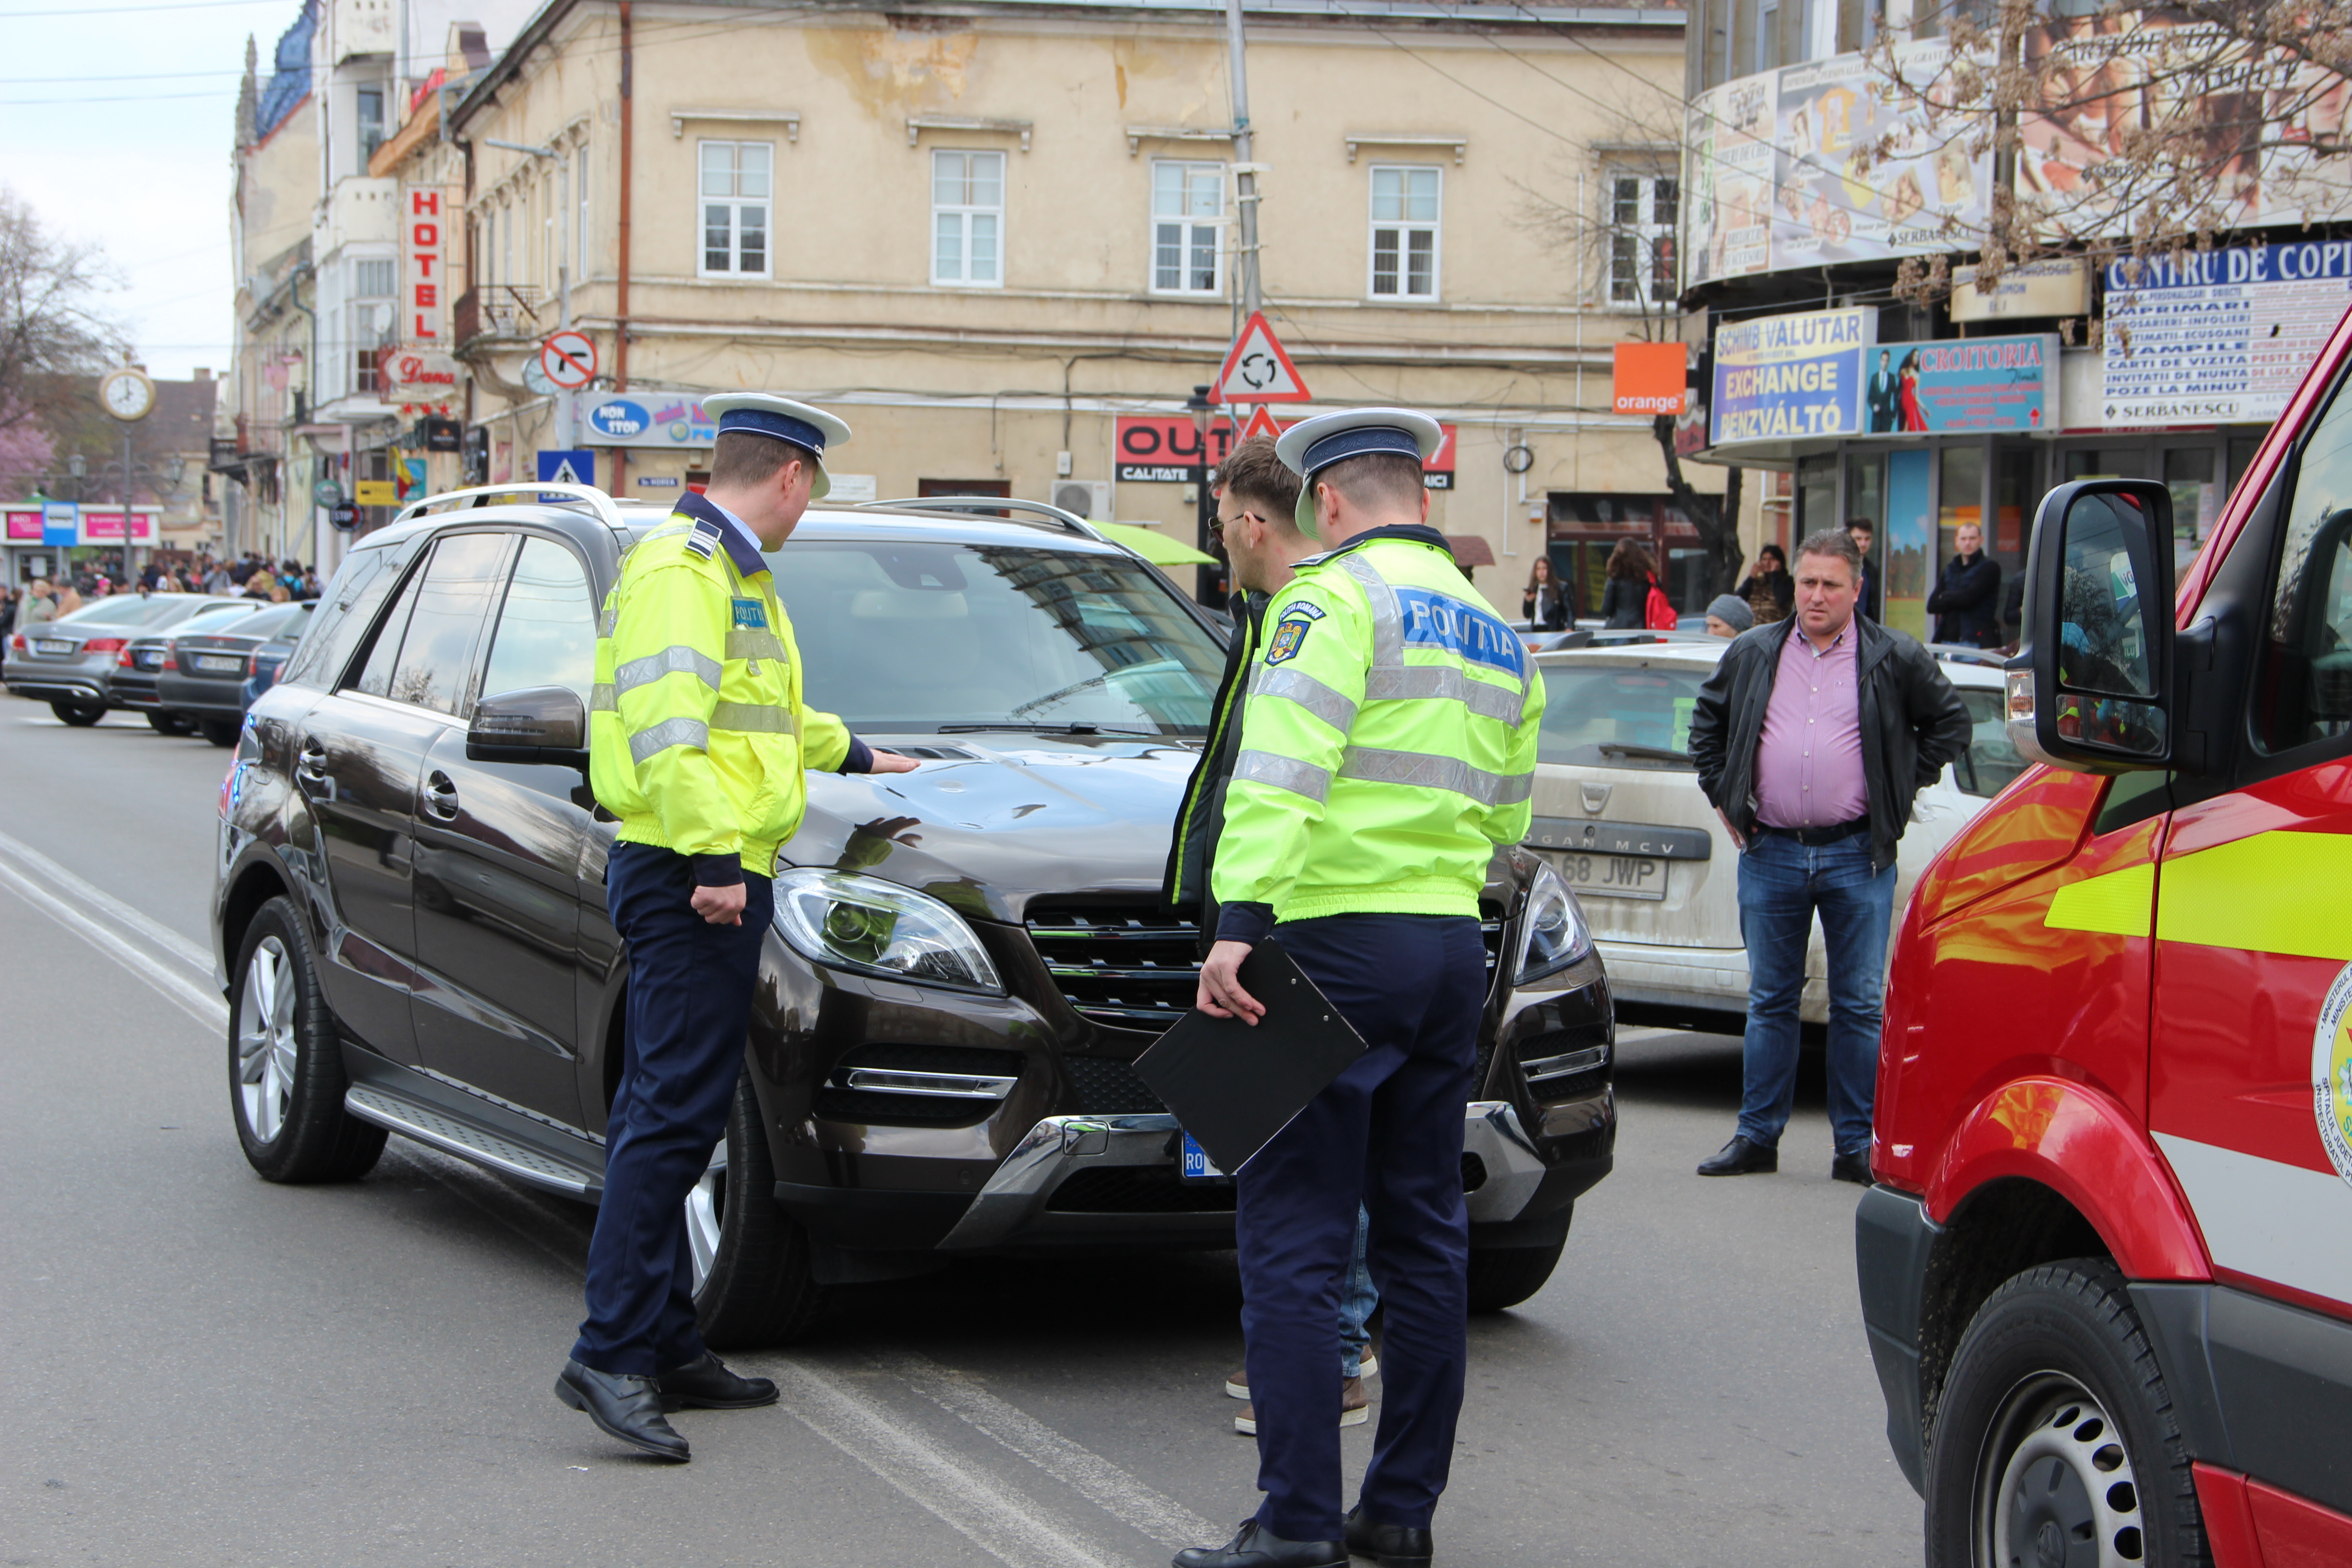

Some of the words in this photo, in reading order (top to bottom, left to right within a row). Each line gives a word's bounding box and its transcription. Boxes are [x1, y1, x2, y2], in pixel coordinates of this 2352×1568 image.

[413, 191, 438, 338] HOTEL
[2109, 250, 2219, 290] CNTRU
[2228, 246, 2268, 283] DE
[1718, 324, 1759, 358] SCHIMB
[1765, 315, 1860, 348] VALUTAR
[400, 356, 454, 385] Dana
[1921, 342, 2042, 372] CROITORIA
[2107, 359, 2154, 369] CARTI
[2161, 358, 2181, 367] DE
[2190, 355, 2248, 365] VIZITA
[2252, 353, 2291, 363] PESTE
[1725, 362, 1838, 400] EXCHANGE
[2106, 386, 2151, 396] POZE
[2159, 384, 2178, 393] LA
[2186, 382, 2248, 392] MINUT
[2107, 372, 2169, 383] INVITATII
[2175, 371, 2191, 380] DE
[2198, 368, 2248, 378] NUNTA
[599, 406, 626, 420] NON
[654, 399, 686, 425] mini
[1617, 396, 1678, 412] orange
[1720, 397, 1842, 440] PÉNZVÁLTÓ
[2123, 402, 2239, 417] SERBANESCU
[608, 421, 641, 434] STOP
[1122, 467, 1188, 480] CALITATE
[335, 510, 354, 521] STOP
[1410, 600, 1516, 663] POLITIA
[1523, 833, 1594, 848] OGAN
[1616, 840, 1674, 854] MCV
[1562, 855, 1592, 882] 68
[1602, 857, 1655, 886] JWP
[2322, 973, 2349, 1024] MINISTERUL
[2331, 985, 2352, 1027] MINISTE
[2322, 1077, 2335, 1135] SPITALUL
[2315, 1084, 2344, 1174] INSPECTORATUL
[1186, 1153, 1203, 1170] RO
